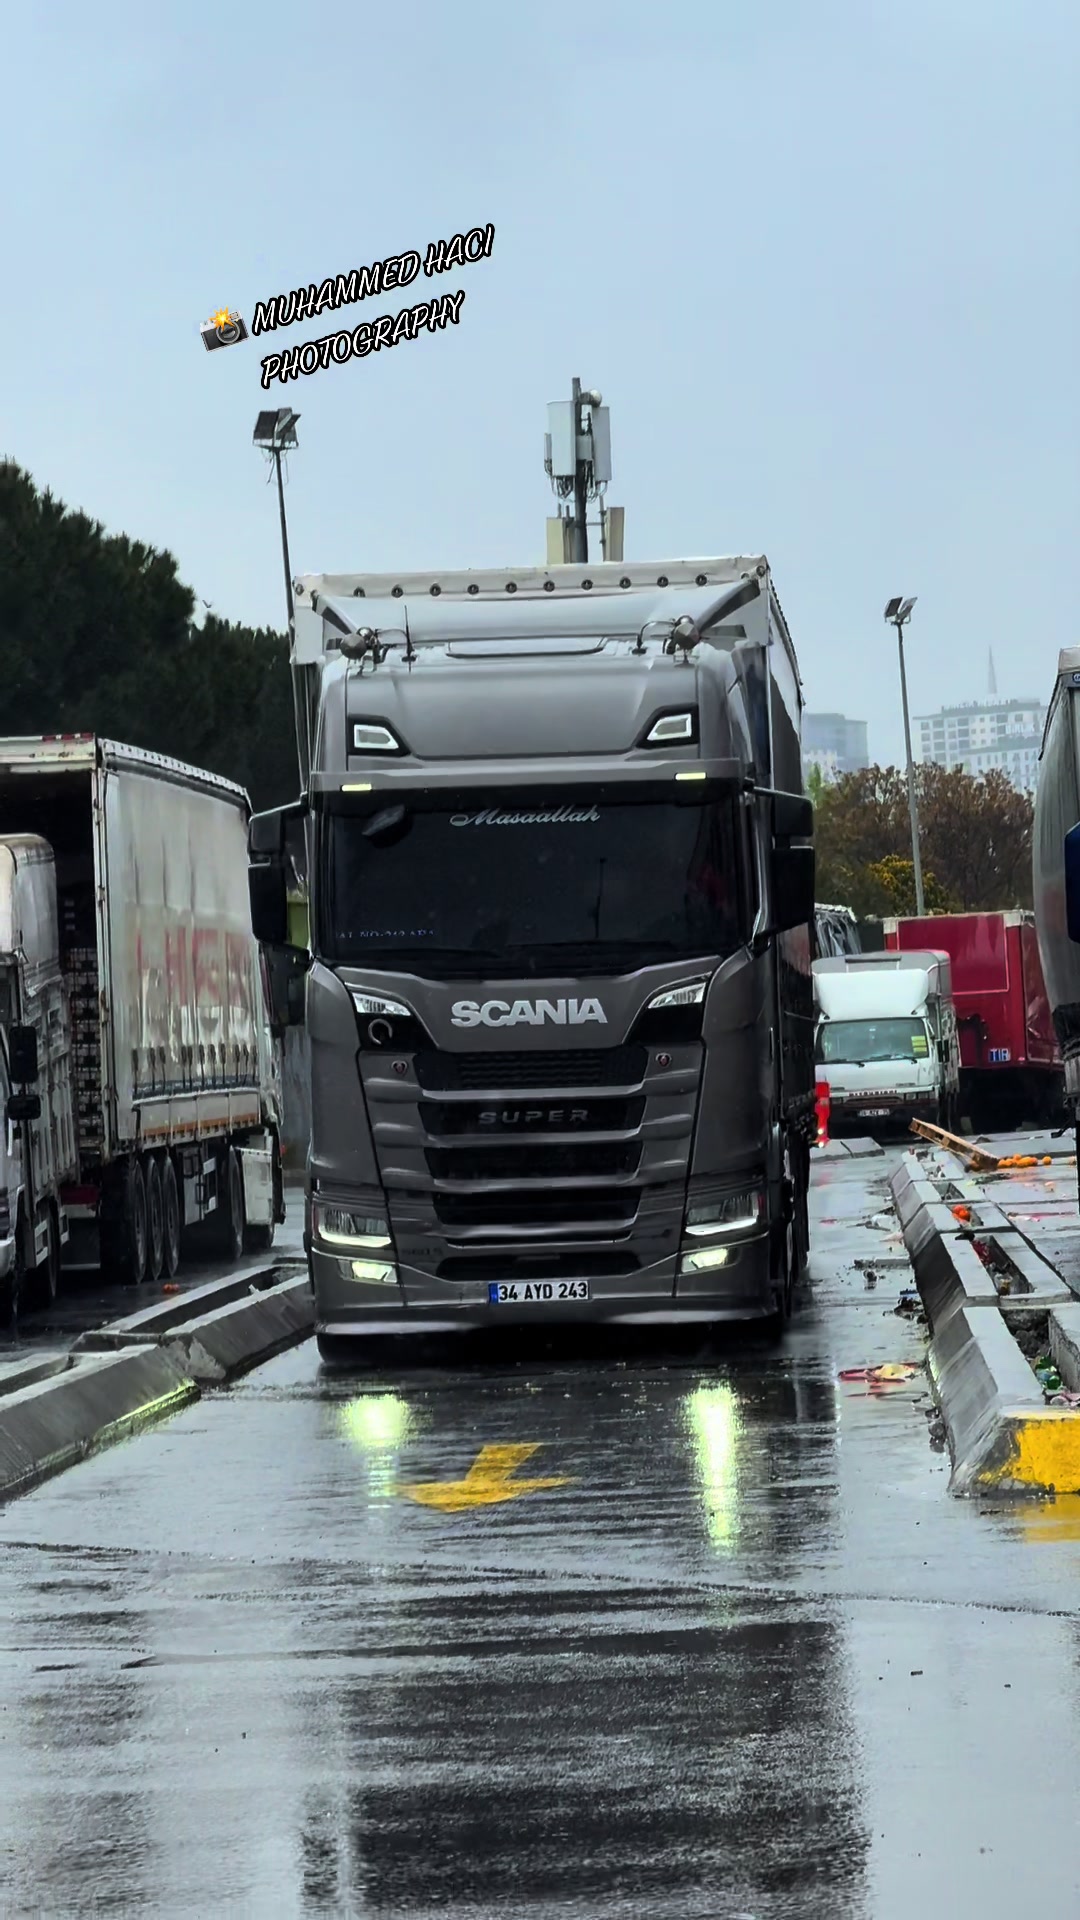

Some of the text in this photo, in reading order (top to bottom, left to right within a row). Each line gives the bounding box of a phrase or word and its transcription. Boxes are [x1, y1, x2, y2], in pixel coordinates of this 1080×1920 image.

[450, 998, 608, 1027] SCANIA
[478, 1109, 588, 1124] SUPER
[499, 1282, 587, 1301] 34 AYD 243
